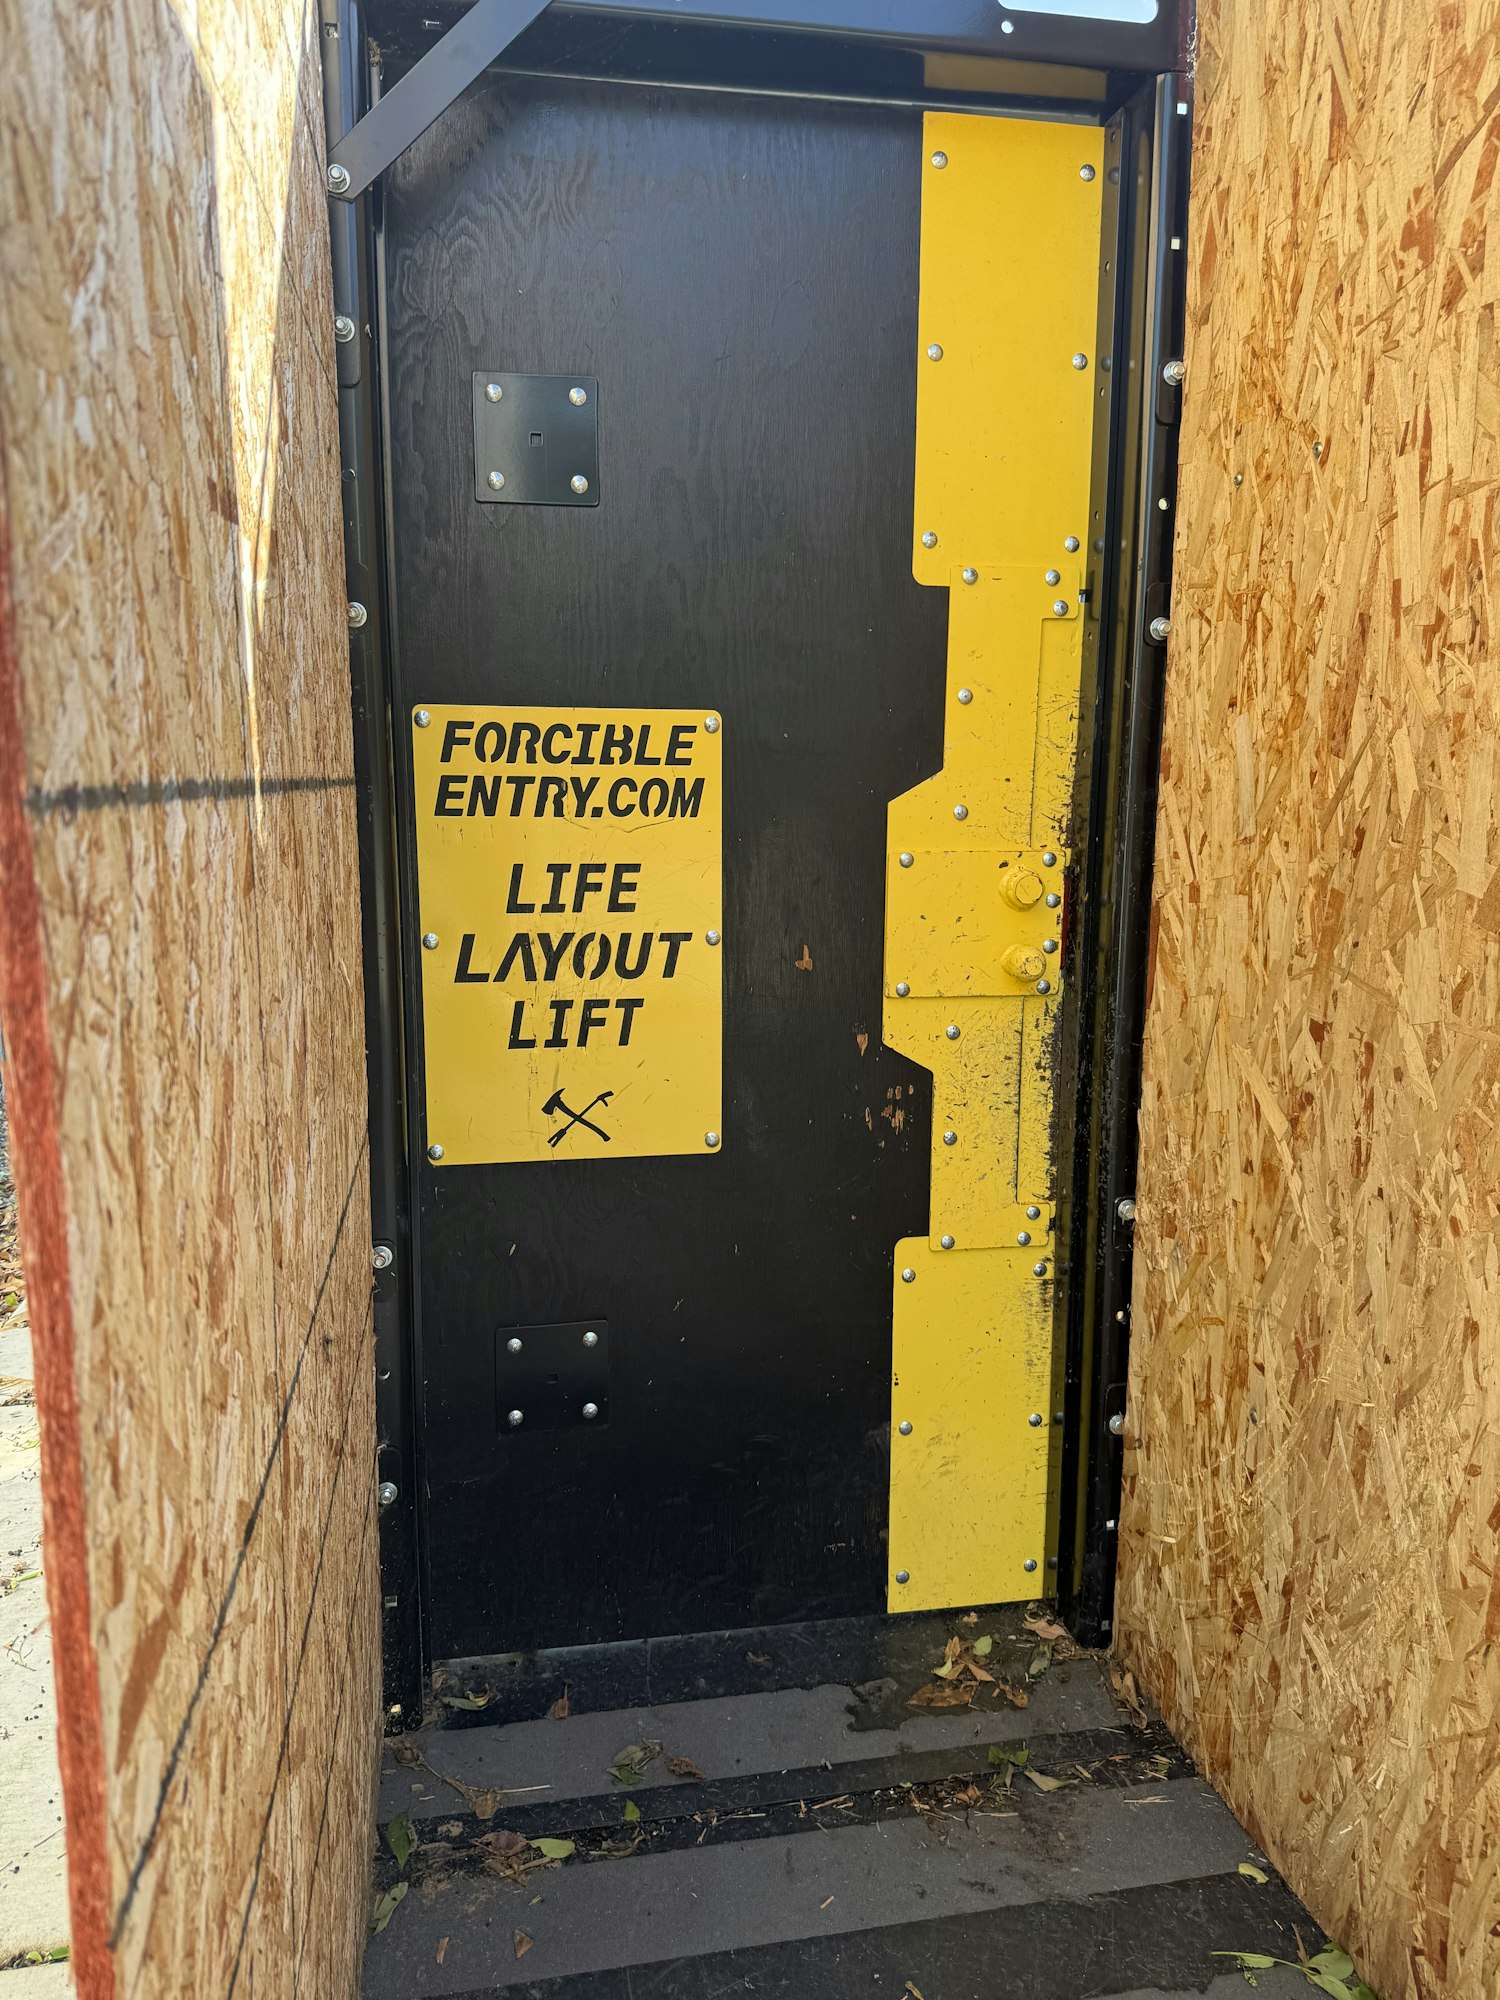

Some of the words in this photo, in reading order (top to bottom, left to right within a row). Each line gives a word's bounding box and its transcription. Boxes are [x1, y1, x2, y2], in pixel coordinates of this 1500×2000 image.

[440, 720, 698, 766] FORCIBLE
[434, 775, 705, 818] ENTRY.COM
[506, 863, 641, 914] LIFE
[454, 932, 692, 983] LAYOUT
[508, 998, 644, 1050] LIFT
